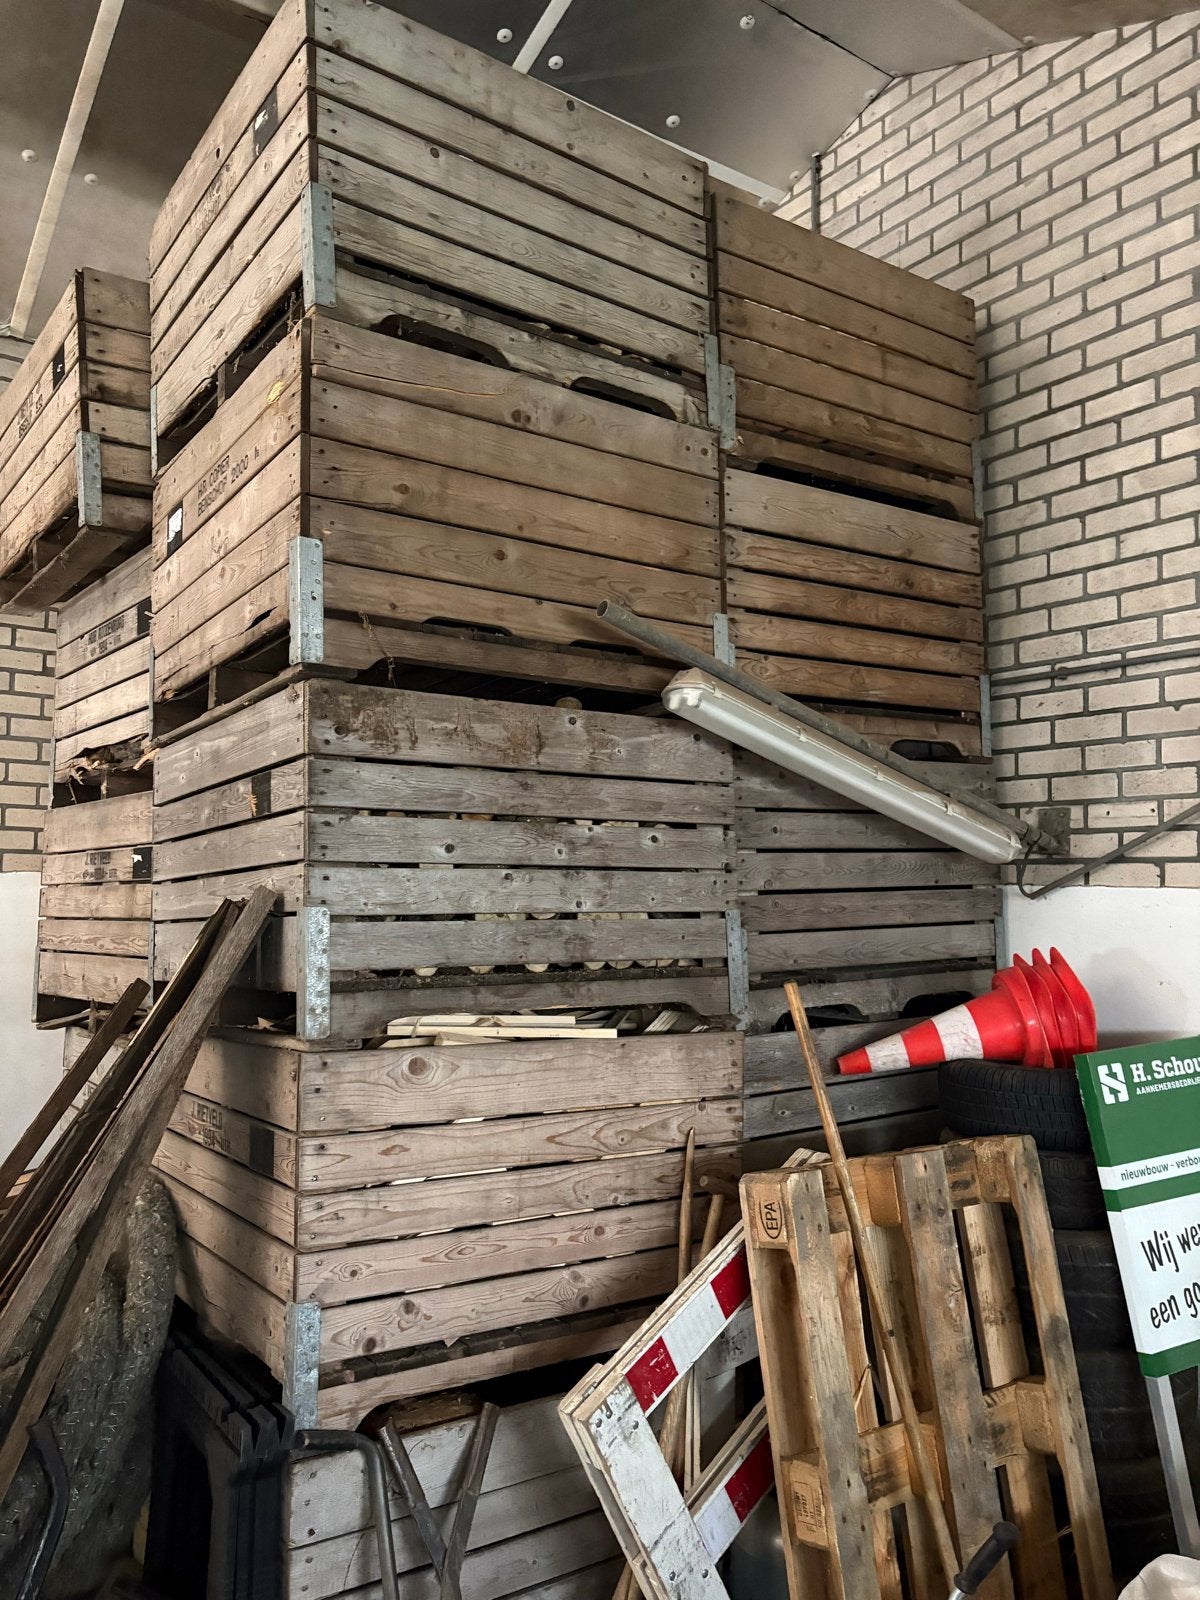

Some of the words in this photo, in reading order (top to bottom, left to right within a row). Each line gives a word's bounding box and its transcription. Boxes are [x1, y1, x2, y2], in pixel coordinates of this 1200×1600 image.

[1121, 1163, 1169, 1182] nieuwbouw
[764, 1201, 779, 1231] EPA
[1140, 1230, 1180, 1273] Wij
[1150, 1294, 1181, 1329] een
